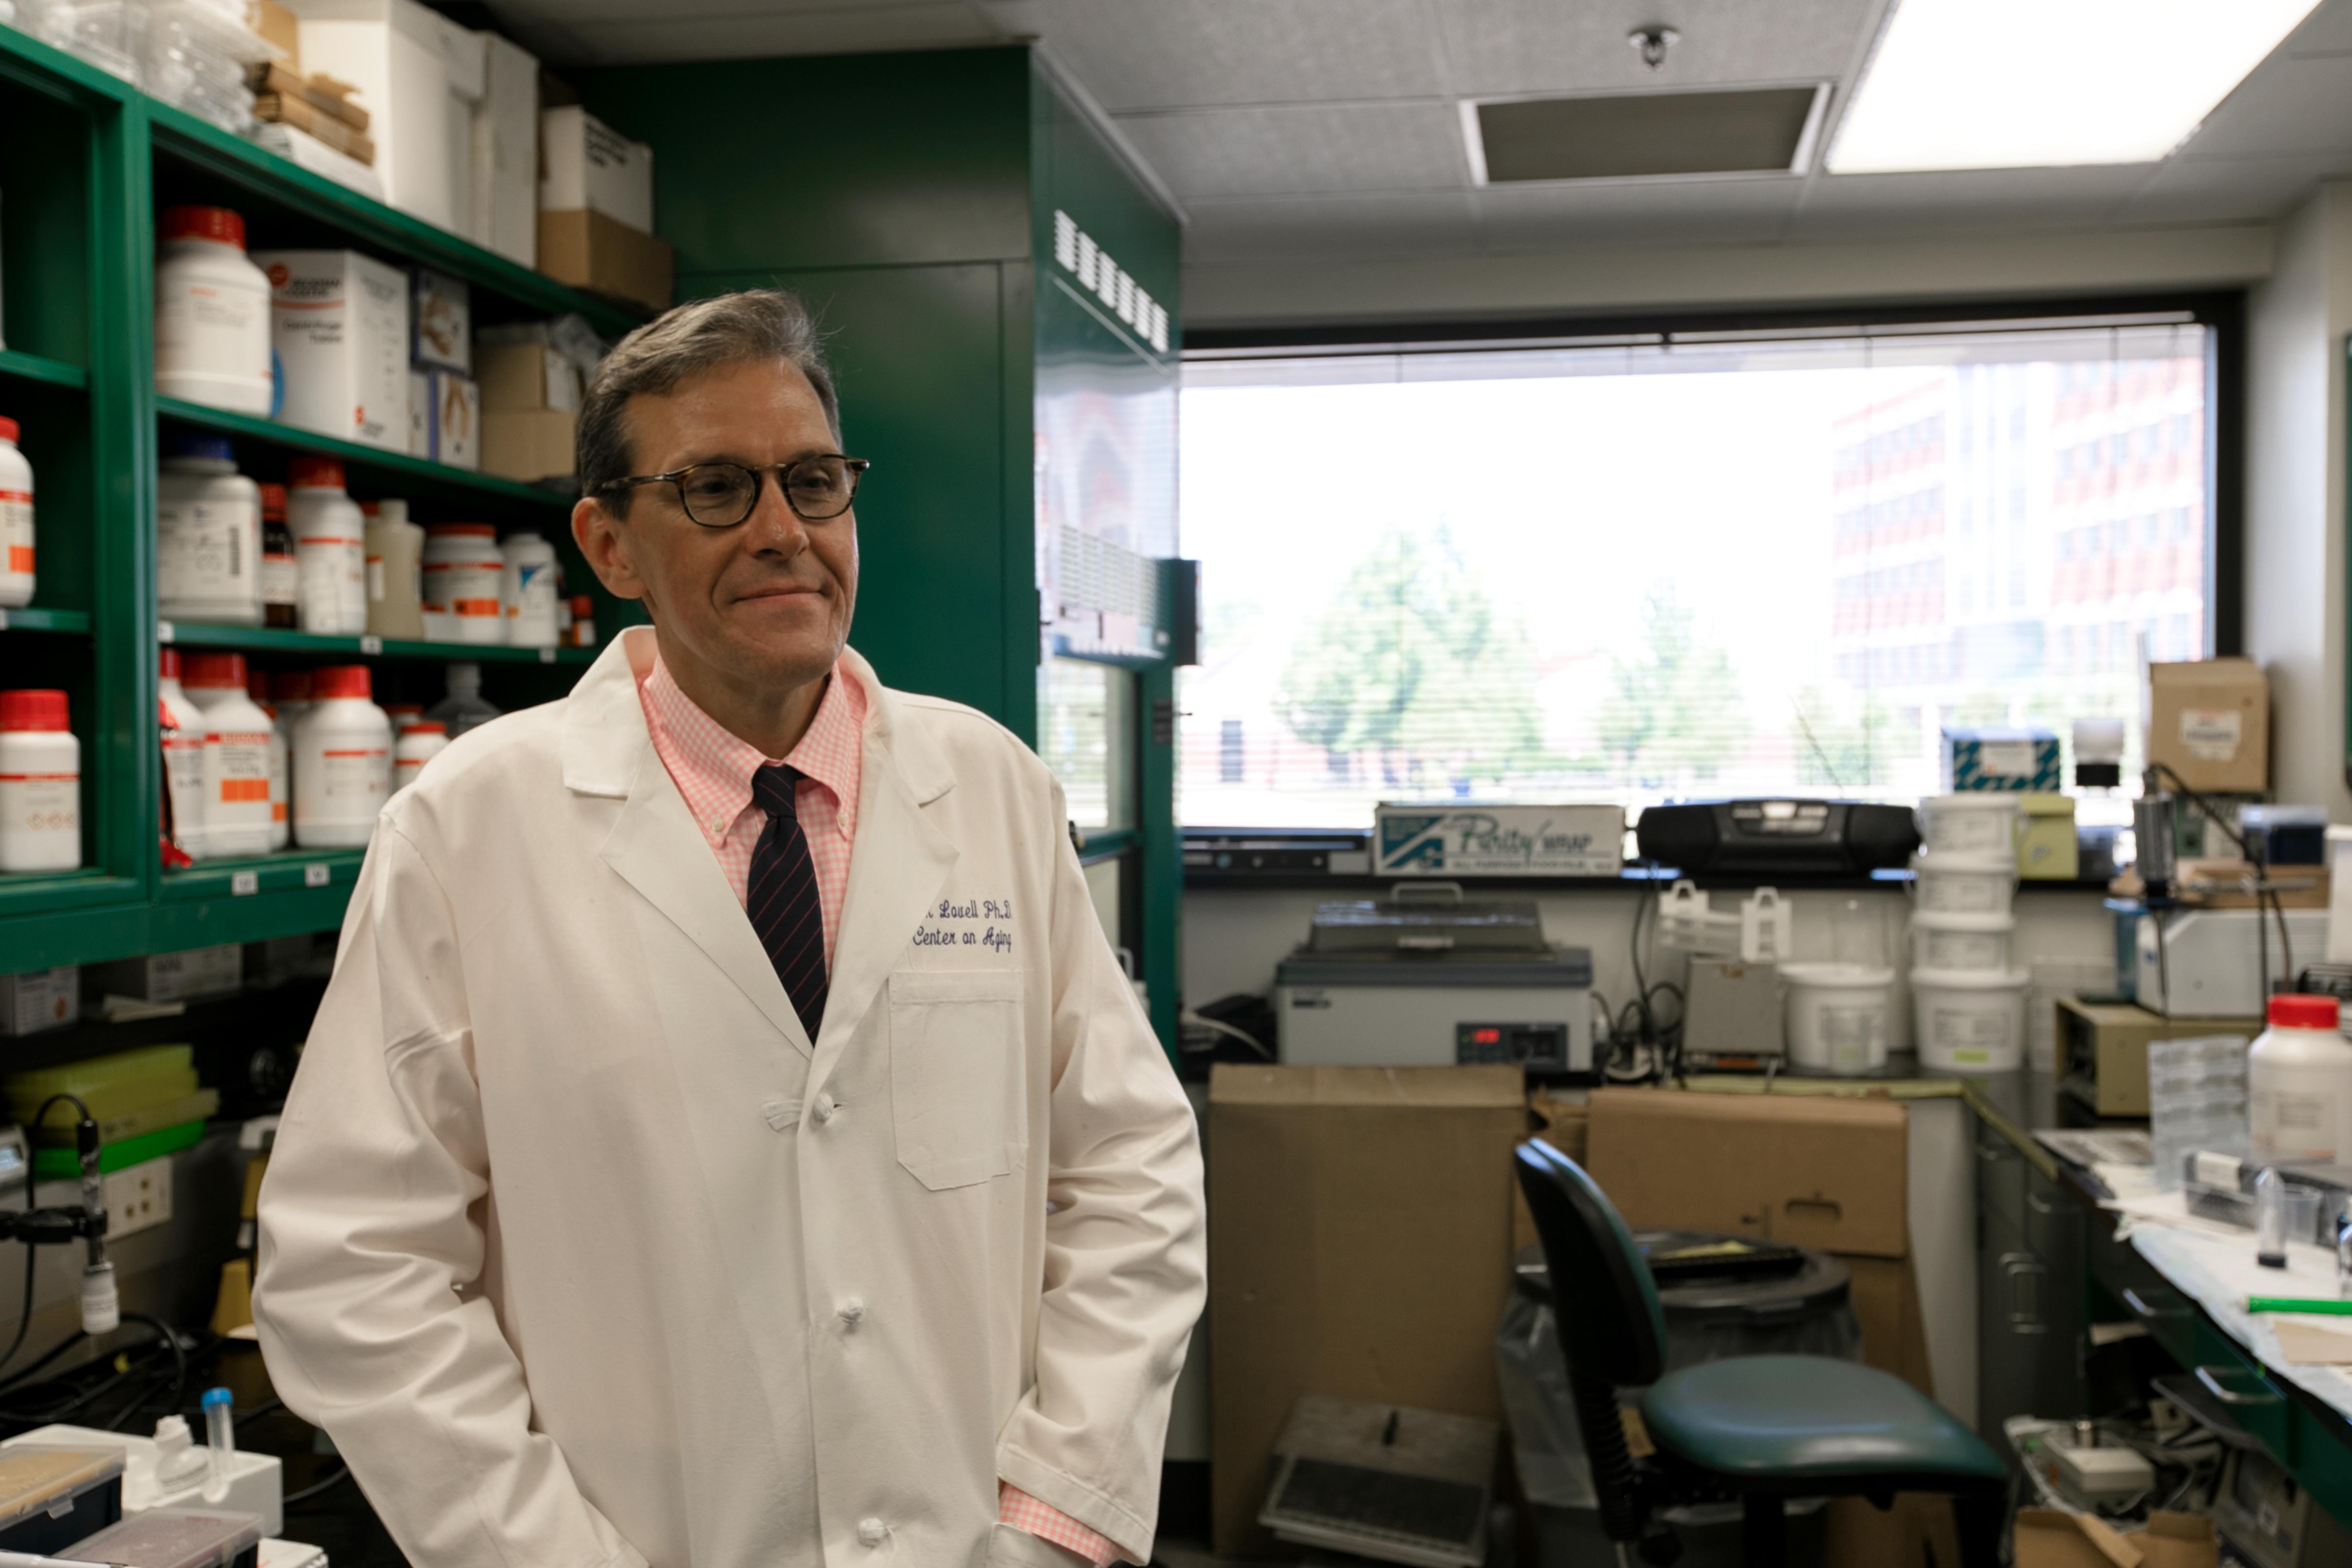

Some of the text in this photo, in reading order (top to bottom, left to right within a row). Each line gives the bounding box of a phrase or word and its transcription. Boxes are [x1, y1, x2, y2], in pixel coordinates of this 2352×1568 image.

[1451, 812, 1553, 866] Purity
[1542, 833, 1592, 852] WRAP
[938, 899, 978, 919] Lovell
[912, 925, 1011, 953] Center on Aging
